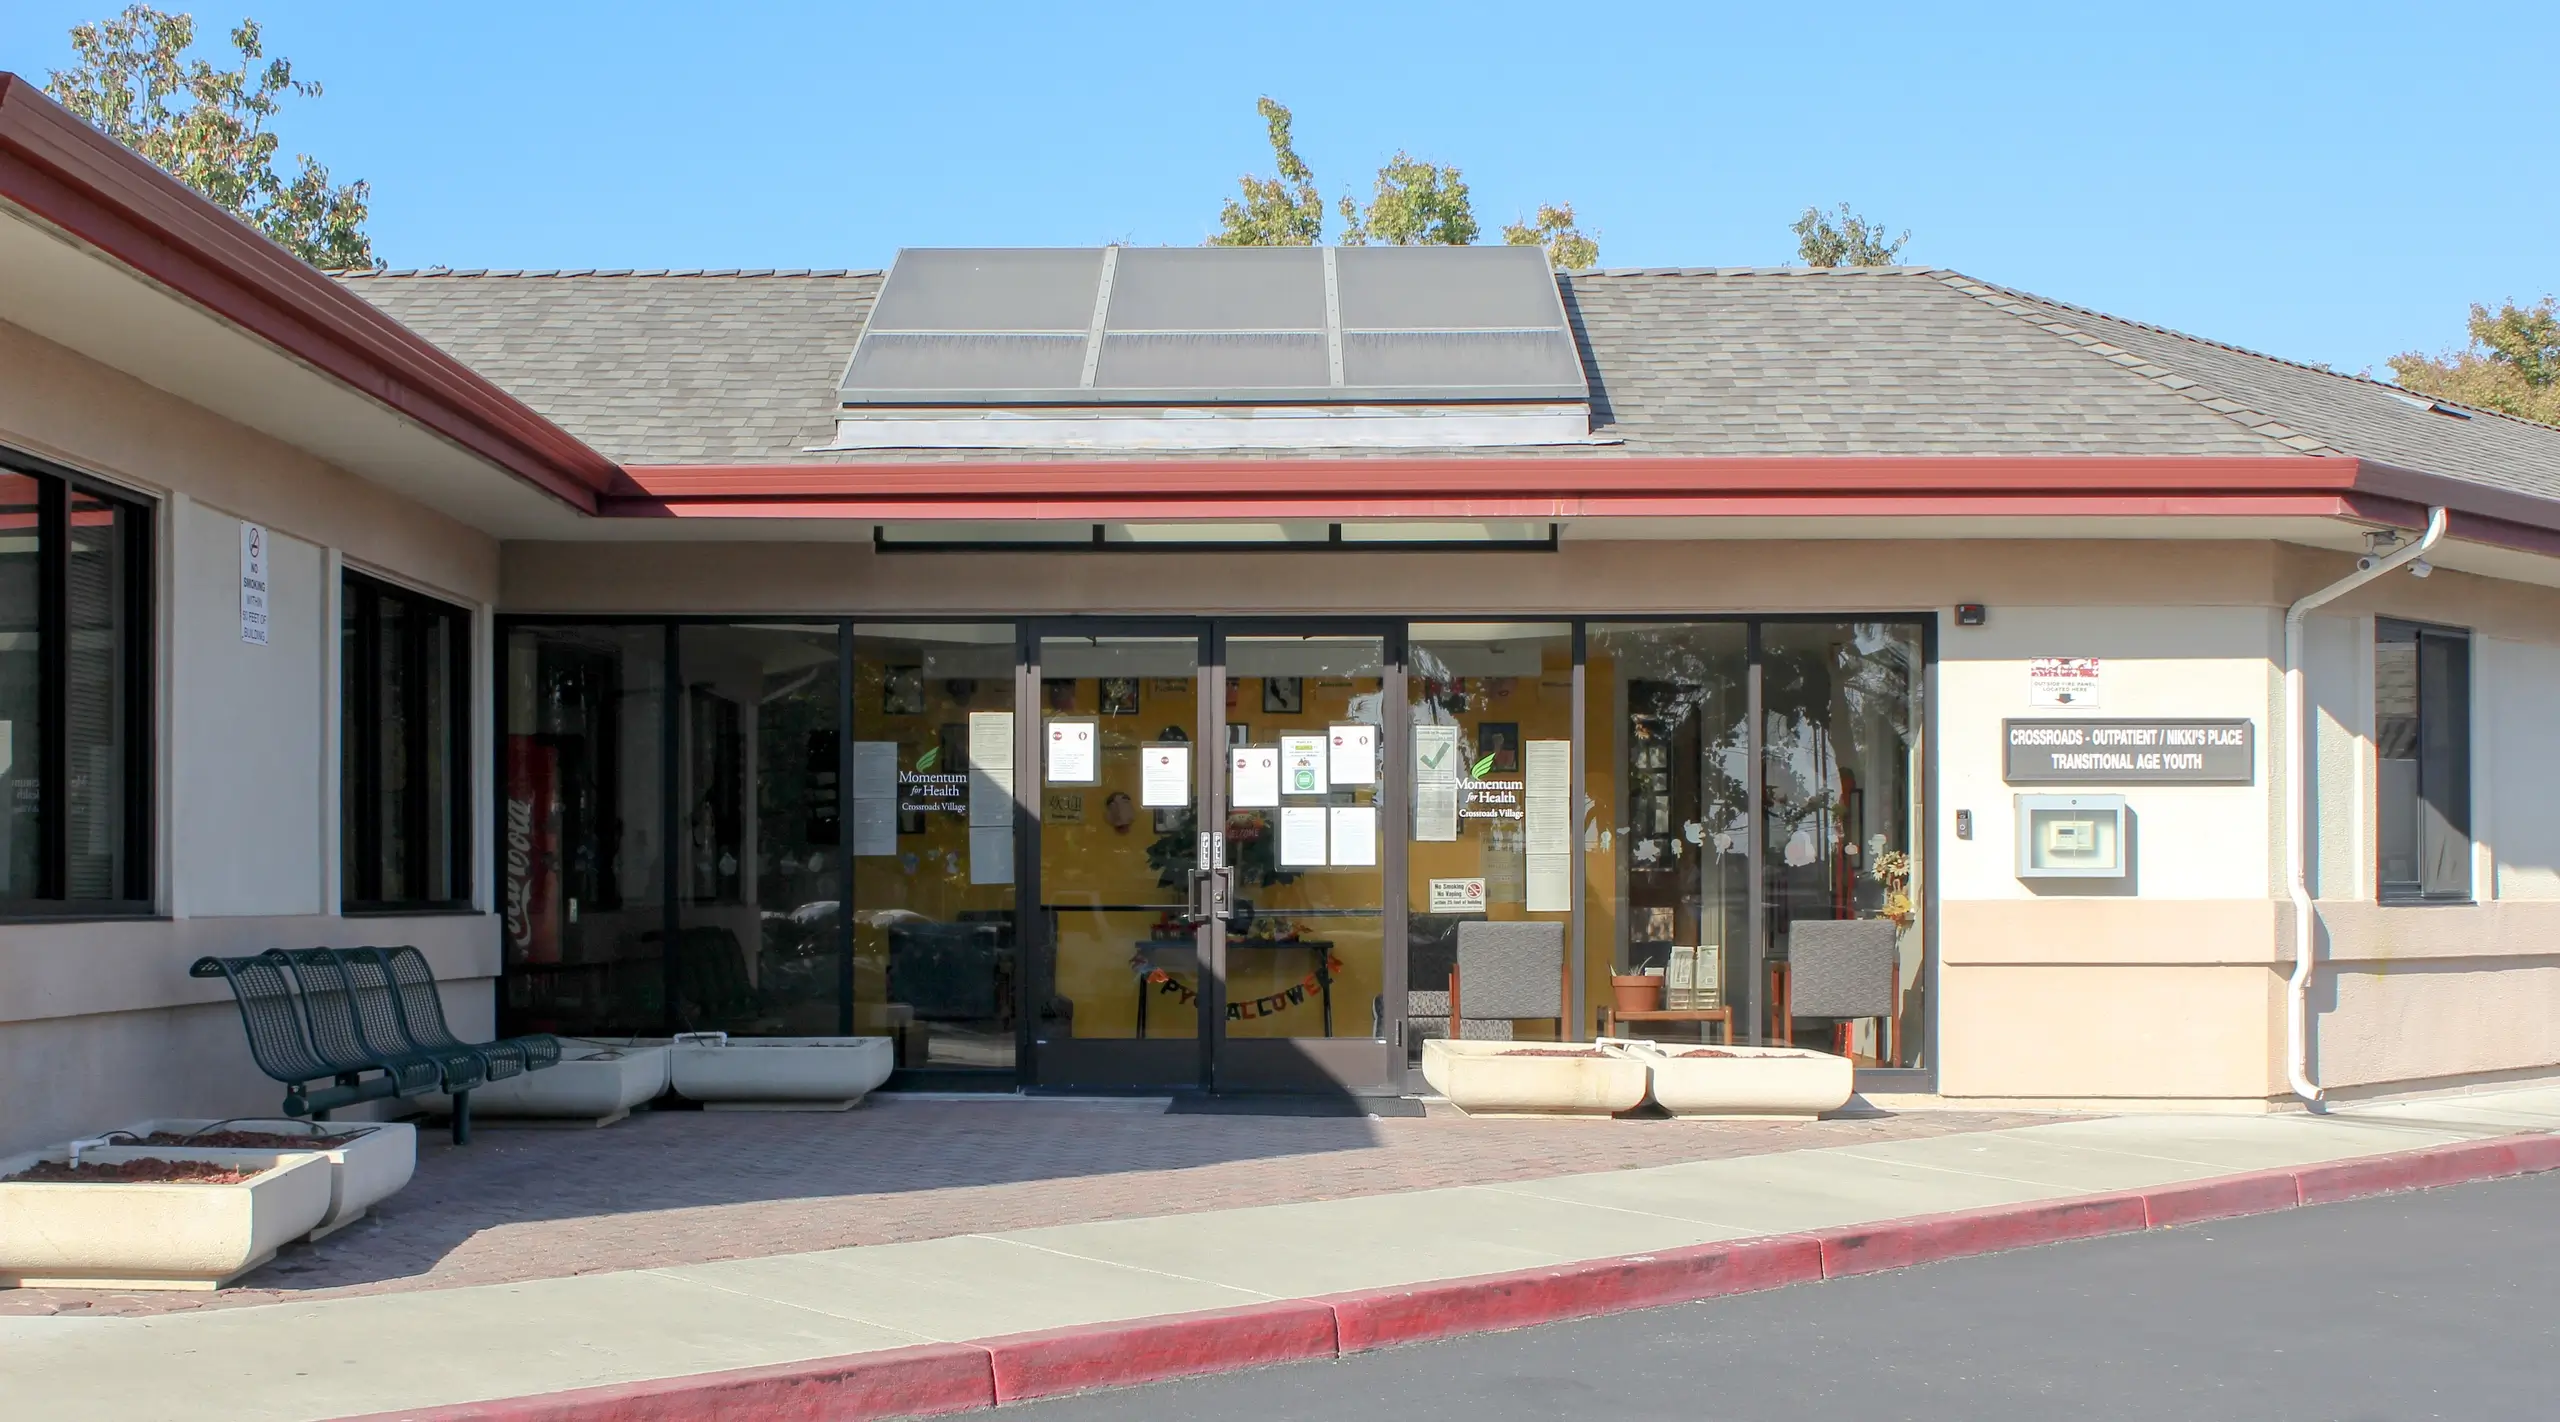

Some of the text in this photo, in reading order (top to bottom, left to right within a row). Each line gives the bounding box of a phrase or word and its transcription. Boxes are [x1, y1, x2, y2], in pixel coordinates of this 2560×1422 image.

[250, 562, 258, 574] NO
[243, 577, 265, 592] SMOKING
[248, 611, 260, 624] FEET
[260, 614, 267, 625] OF
[244, 627, 265, 641] BUILDING
[2010, 729, 2083, 745] CROSSROADS
[2092, 729, 2157, 745] OUTPATIENT
[2159, 729, 2164, 745] /
[2166, 729, 2205, 745] NIKKI'S
[2208, 729, 2243, 745] PLACE
[2051, 754, 2202, 769] TRANSITIONAL AGE YOUTH
[899, 771, 967, 783] Momentum
[1455, 777, 1523, 790] Momentum
[910, 784, 960, 796] for Health
[1465, 791, 1516, 803] for Health
[902, 802, 966, 813] Crossroads Village
[1459, 809, 1524, 820] Crossroads Village
